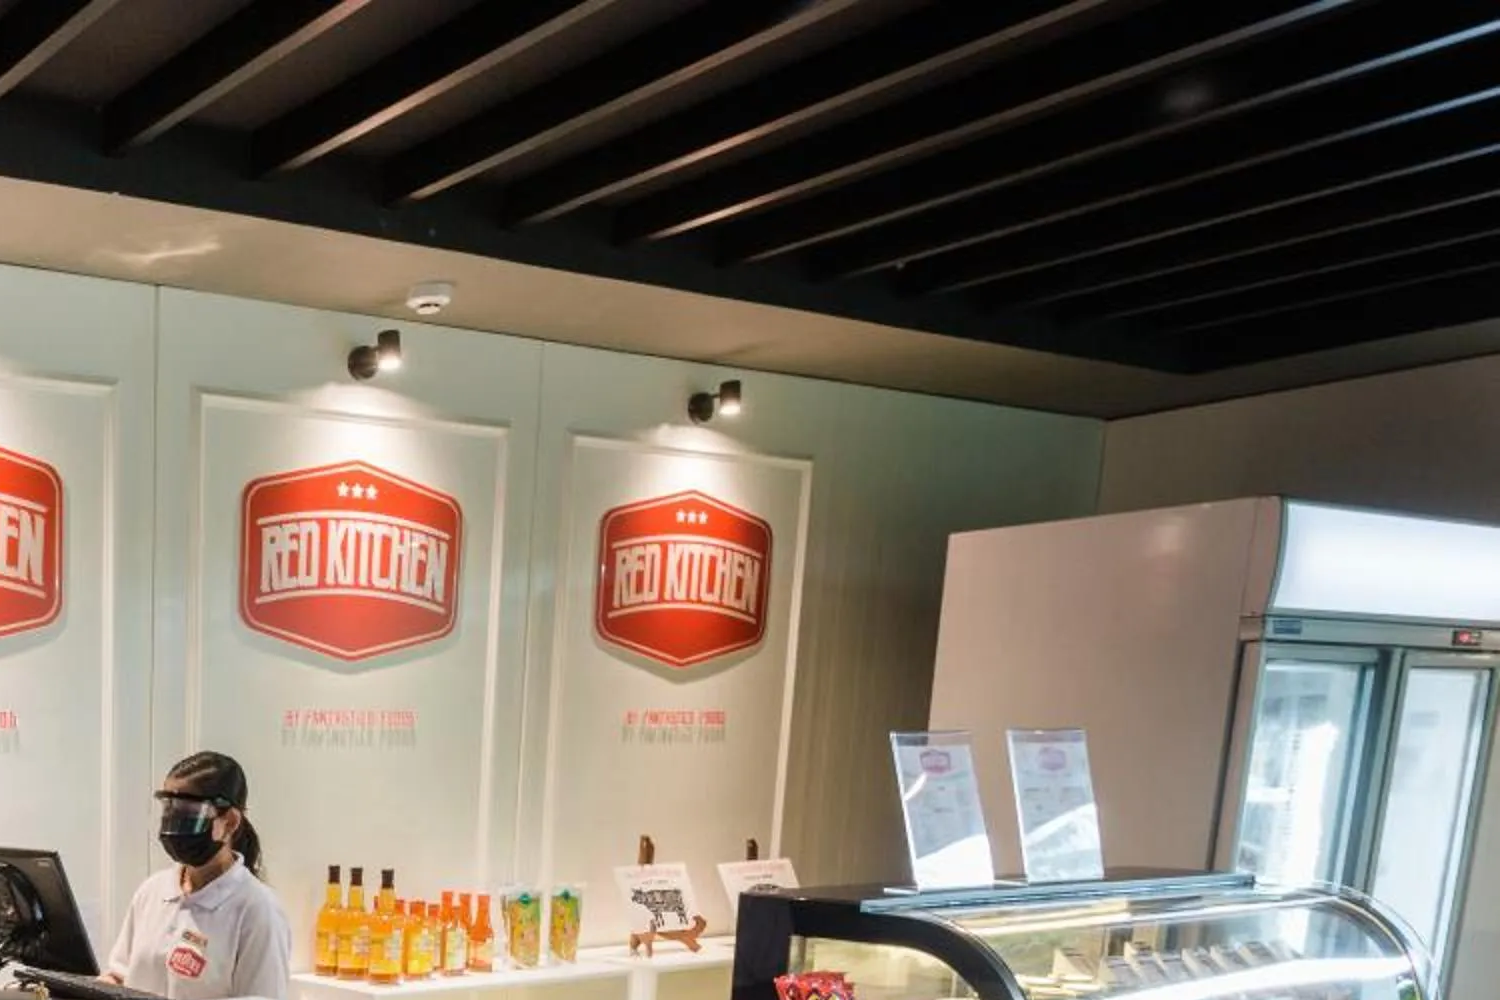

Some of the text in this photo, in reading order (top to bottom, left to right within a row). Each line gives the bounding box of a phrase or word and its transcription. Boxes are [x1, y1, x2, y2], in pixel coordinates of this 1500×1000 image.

[260, 519, 449, 603] RED KITCHEN
[612, 543, 761, 614] RED KITCHEN
